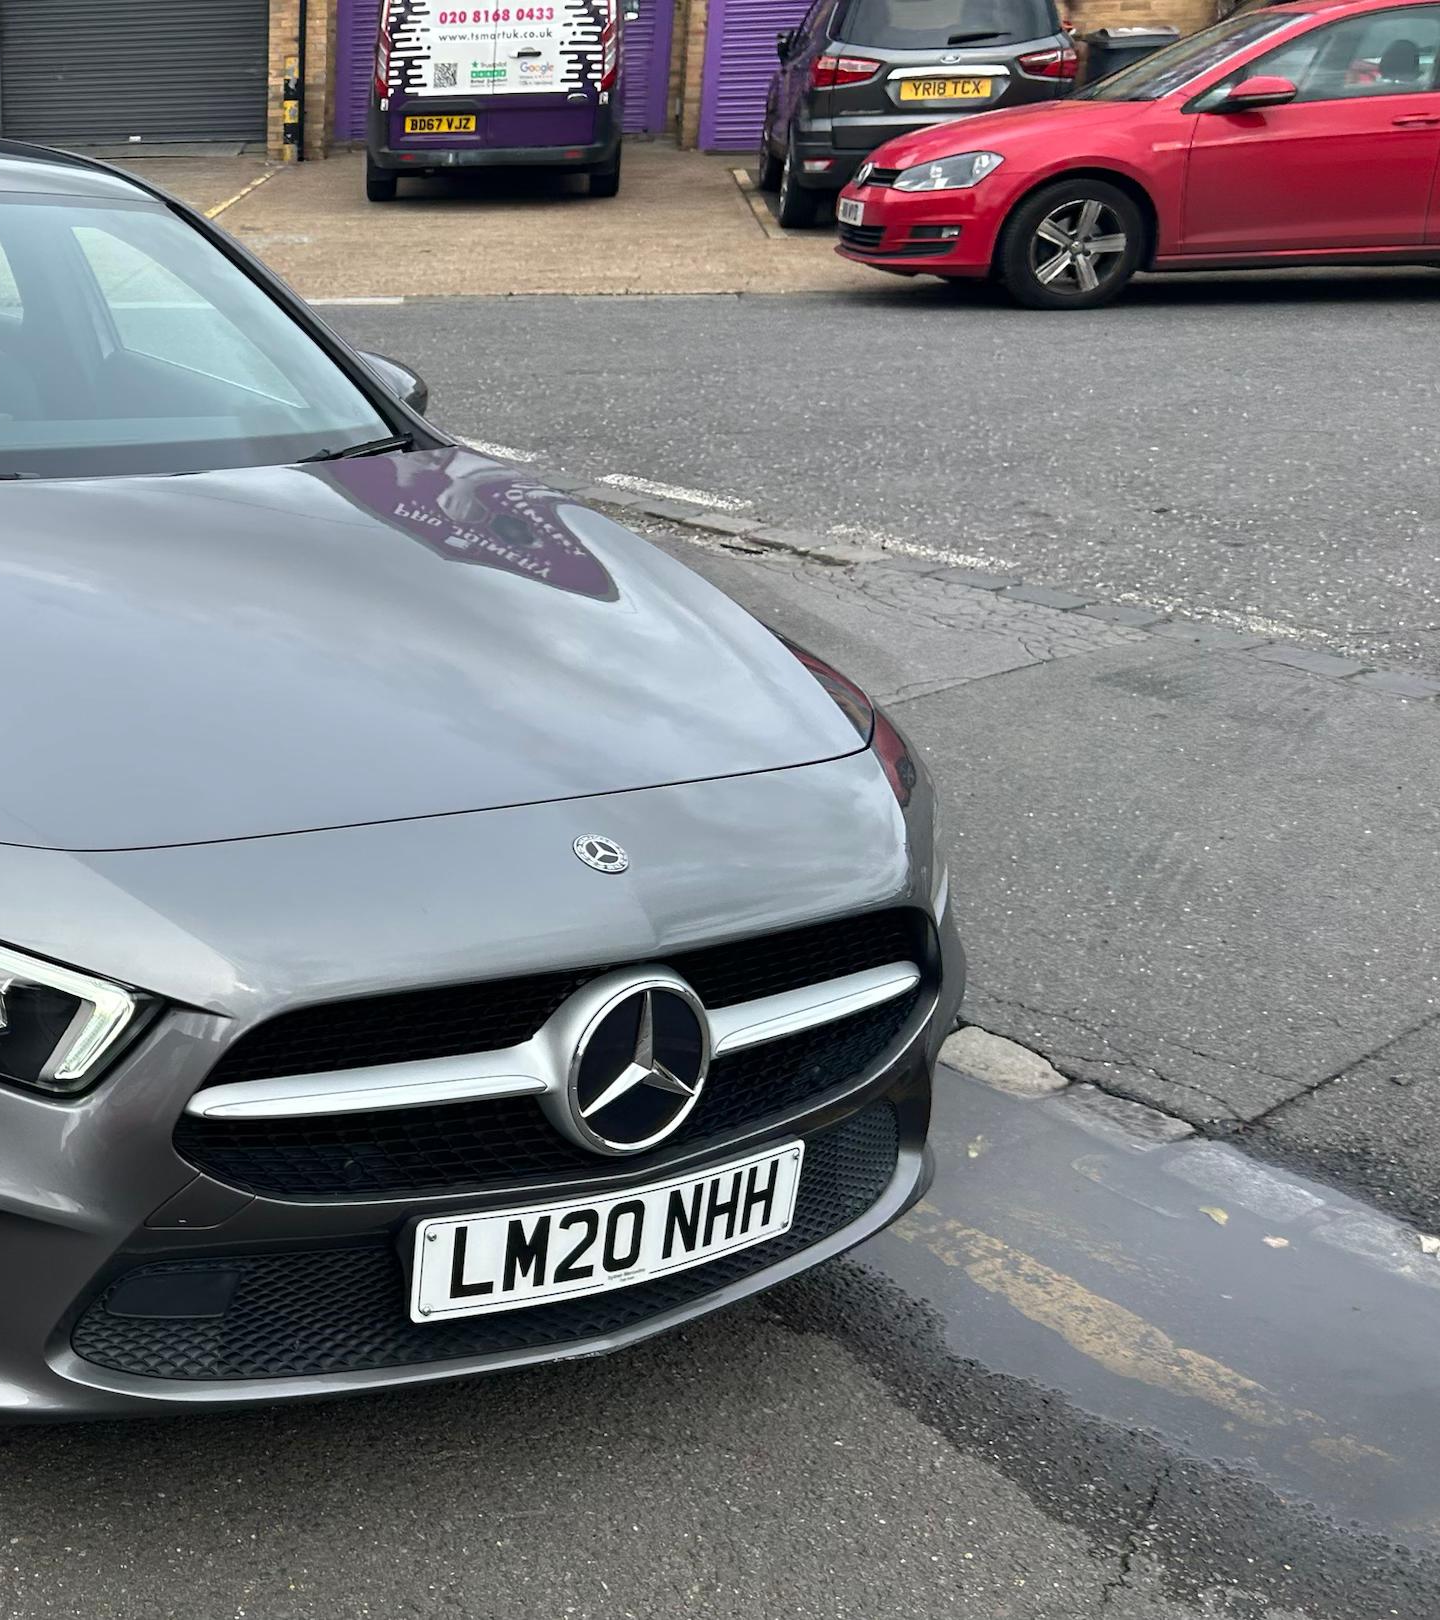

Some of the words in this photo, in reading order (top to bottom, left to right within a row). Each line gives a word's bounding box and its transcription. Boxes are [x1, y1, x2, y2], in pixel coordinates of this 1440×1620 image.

[439, 11, 467, 24] 020
[472, 9, 510, 23] 8168
[516, 7, 554, 21] 0433
[438, 28, 553, 41] www.tsmartuk.co.uk
[520, 61, 554, 74] Google
[912, 81, 947, 97] YR18
[951, 80, 981, 95] TCX
[410, 118, 443, 131] BD67
[446, 117, 471, 130] VJZ
[449, 1199, 645, 1299] LM20
[661, 1159, 780, 1260] NHH
